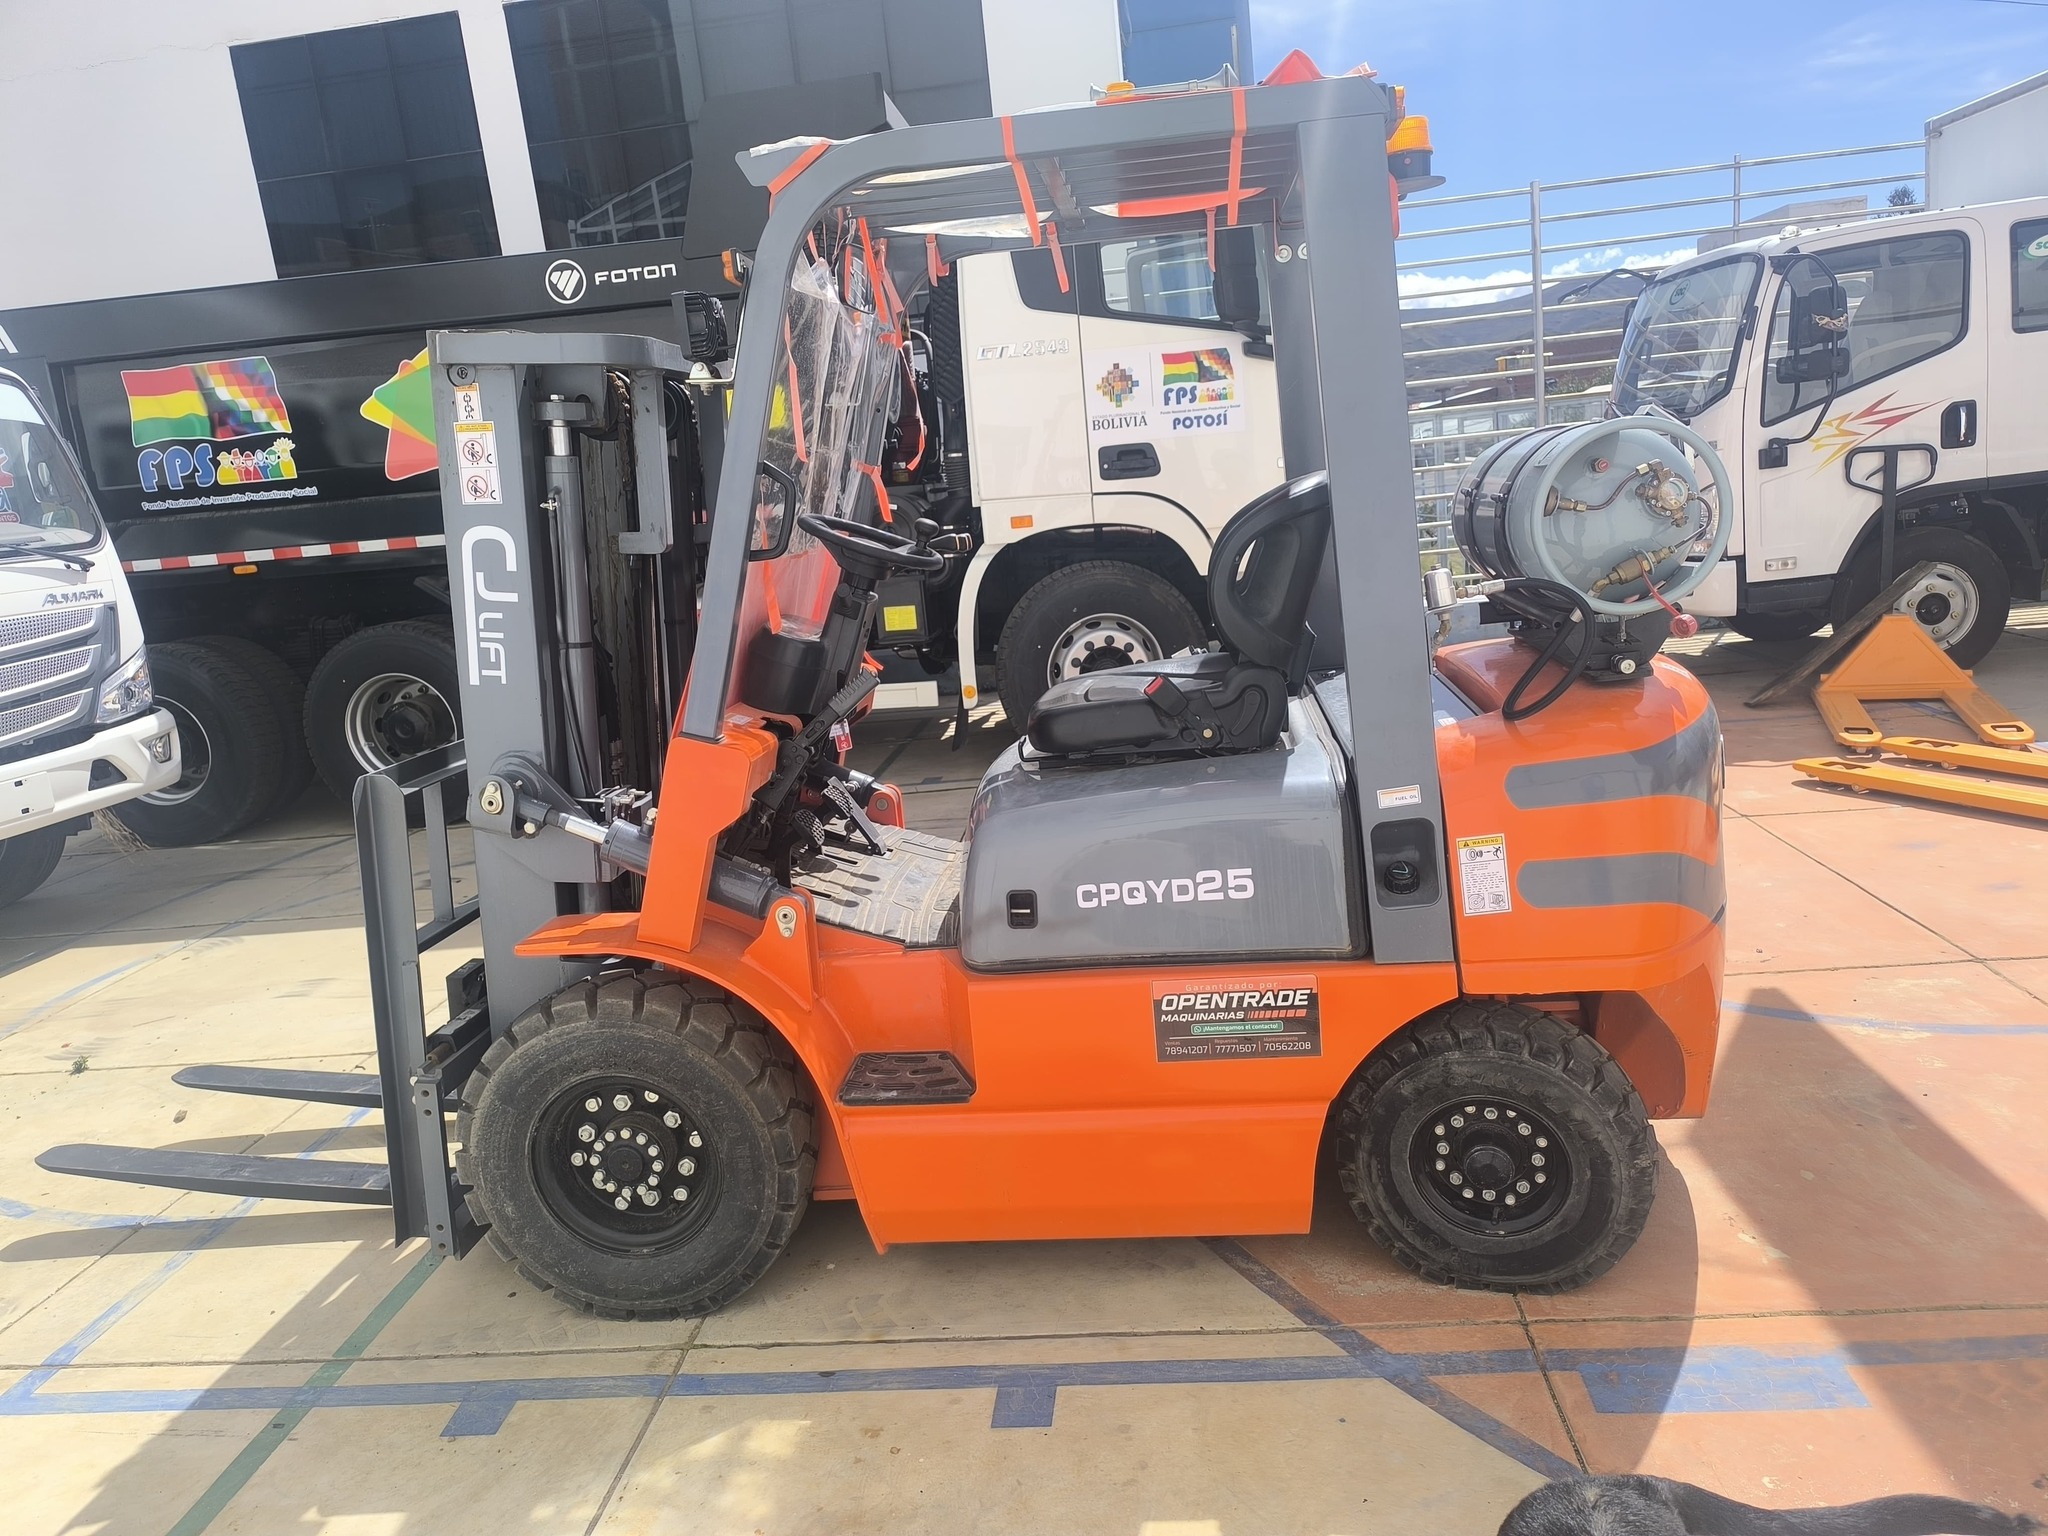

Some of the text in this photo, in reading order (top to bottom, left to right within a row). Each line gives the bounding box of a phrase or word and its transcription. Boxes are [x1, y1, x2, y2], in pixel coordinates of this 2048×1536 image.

[595, 264, 676, 285] FOTON
[1164, 385, 1197, 406] FPS
[1092, 415, 1148, 431] BOLIVIA
[1172, 410, 1228, 430] POTOSÍ
[138, 443, 216, 493] FPS
[141, 501, 167, 511] Fondo
[167, 498, 200, 508] Nacional
[200, 496, 211, 505] de
[246, 489, 287, 501] Productiva
[293, 486, 318, 497] Social
[1472, 838, 1499, 846] WARNING
[1076, 868, 1255, 909] CPQYD25
[1185, 981, 1282, 992] Garantizado por:
[1161, 989, 1311, 1011] OPENTRADE
[1160, 1011, 1245, 1023] MAQUINARIAS
[1165, 1042, 1311, 1055] 78941207 77771507 70562208
